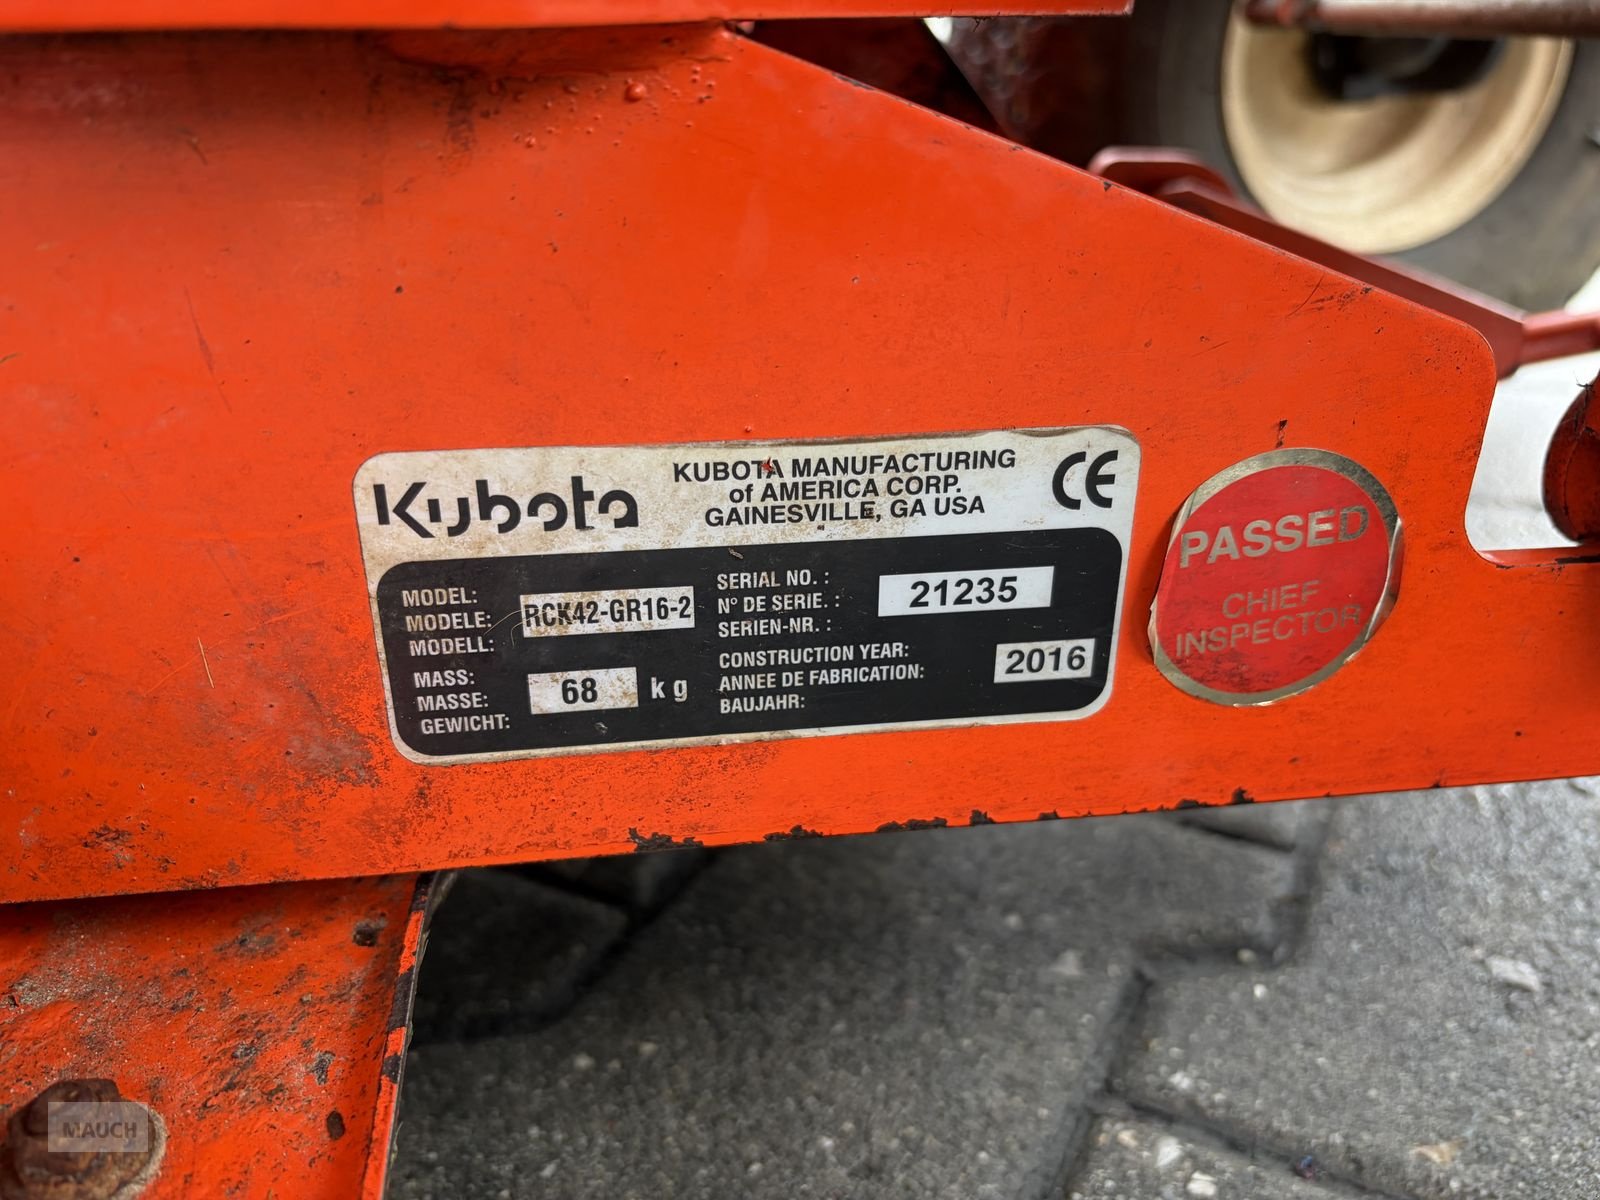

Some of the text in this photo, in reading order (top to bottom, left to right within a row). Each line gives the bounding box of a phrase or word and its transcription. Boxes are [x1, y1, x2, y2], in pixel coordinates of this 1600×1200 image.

[673, 449, 1016, 482] KUBOTA MANUFACTURING
[729, 475, 961, 503] of AMERICA CORP.
[1052, 450, 1118, 510] CE
[373, 476, 639, 538] Kubota
[705, 496, 985, 527] GAINESVILLE, GA USA
[1179, 505, 1370, 568] PASSED
[716, 571, 781, 590] SERIAL
[909, 576, 1018, 608] 21235
[402, 588, 477, 607] MODEL:
[524, 595, 692, 628] RCK42-GR16-2
[743, 596, 766, 613] DE
[1222, 580, 1320, 619] CHIEF
[405, 612, 492, 632] MODELE:
[1176, 603, 1361, 657] INSPECTOR
[409, 637, 494, 656] MODELL:
[719, 642, 909, 669] CONSTRUCTION YEAR:
[1004, 645, 1086, 675] 2016
[413, 669, 475, 688] MASS:
[561, 678, 598, 704] 68
[719, 664, 925, 692] ANNEE DE FABRICATION:
[417, 692, 489, 711] MASSE:
[720, 694, 805, 714] BAUJAHR:
[420, 714, 510, 735] GEWICHT:
